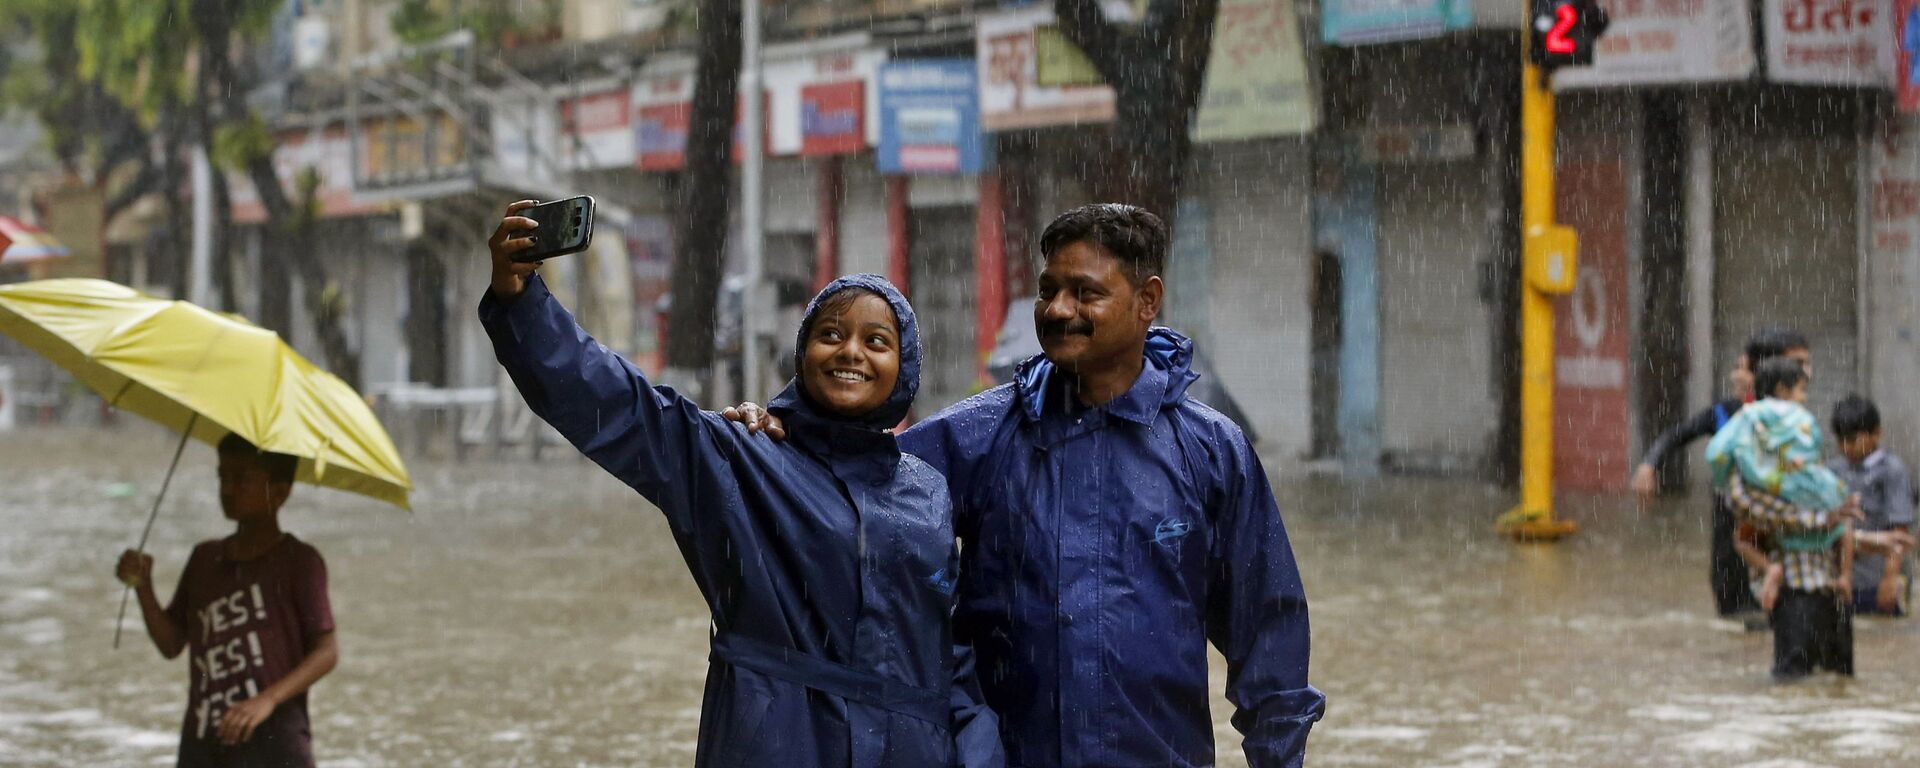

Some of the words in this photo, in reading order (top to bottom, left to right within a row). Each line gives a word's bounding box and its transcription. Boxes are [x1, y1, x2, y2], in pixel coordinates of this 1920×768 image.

[1546, 3, 1578, 53] 2
[198, 584, 266, 645] YES!
[195, 631, 263, 692] YES!
